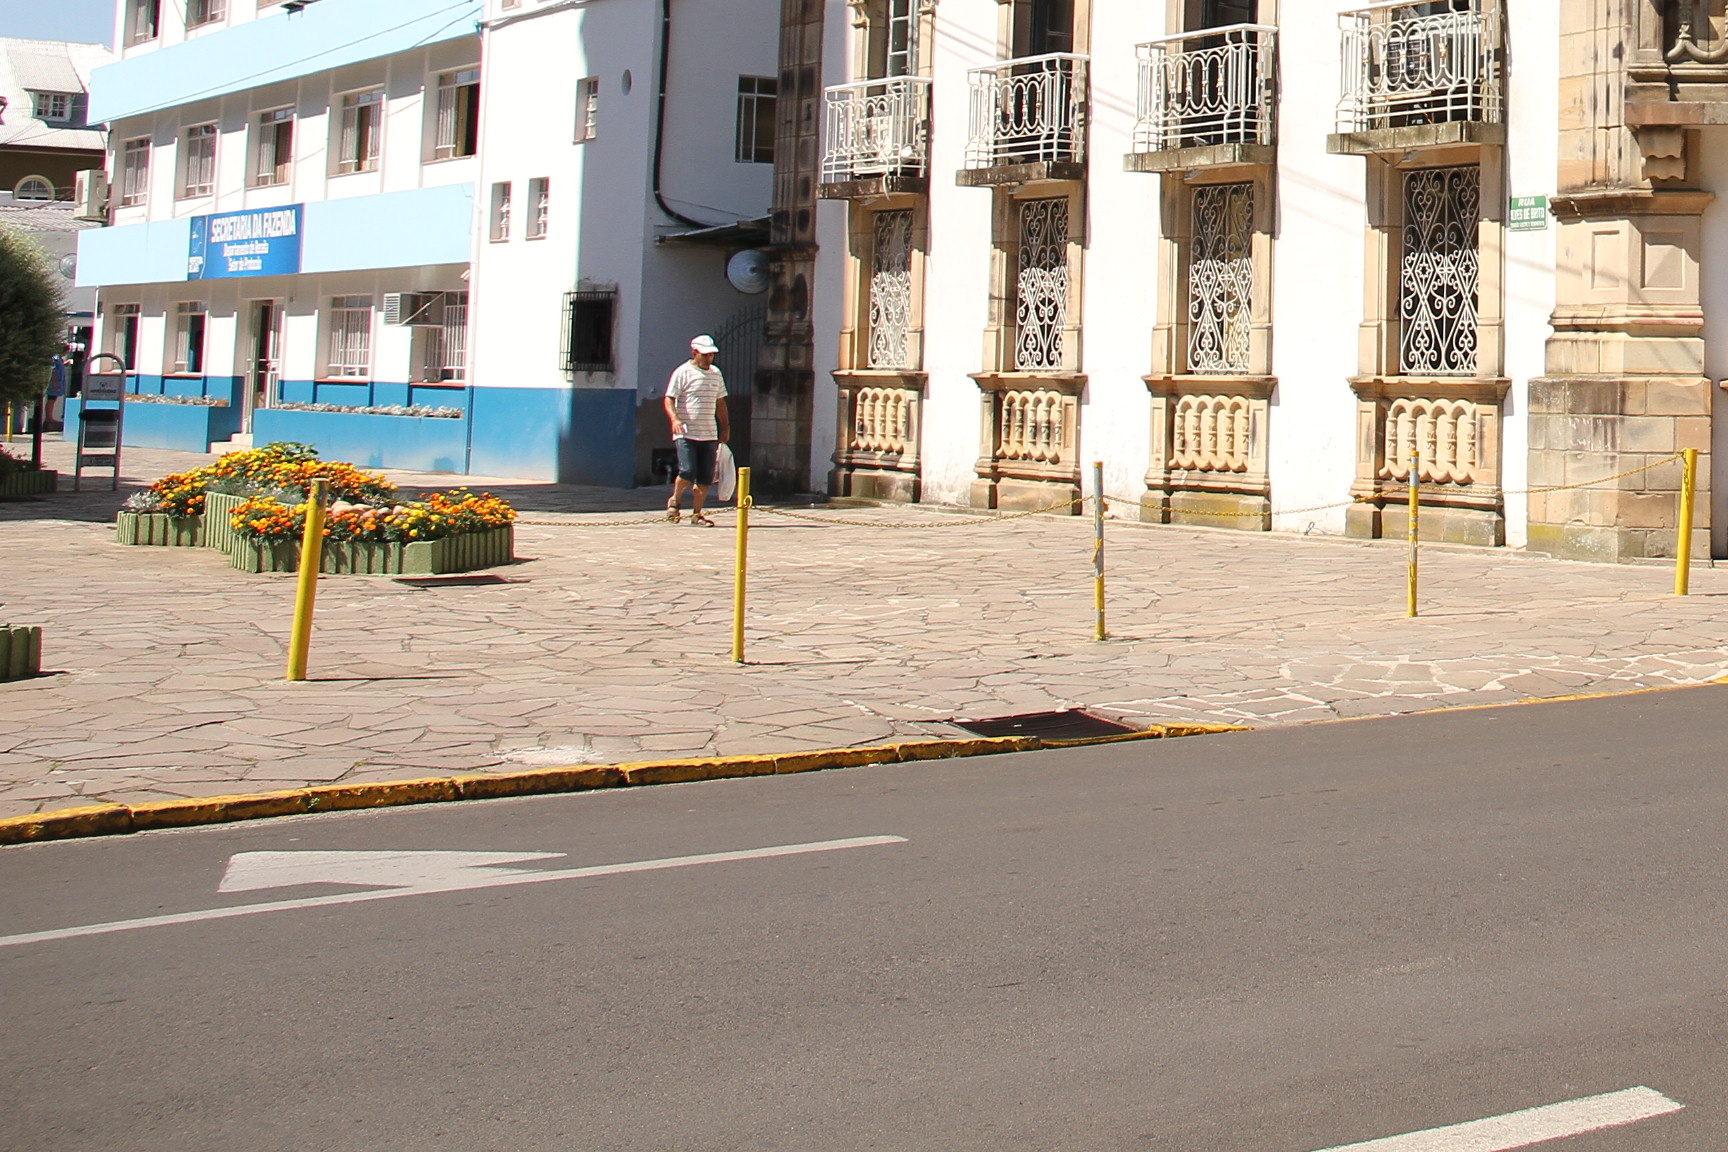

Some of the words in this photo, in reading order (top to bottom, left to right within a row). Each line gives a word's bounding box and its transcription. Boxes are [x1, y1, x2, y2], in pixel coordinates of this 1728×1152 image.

[1518, 198, 1535, 207] RUA
[211, 215, 252, 243] SECRETARIA
[253, 213, 263, 238] DA
[263, 209, 296, 238] FAZENDA
